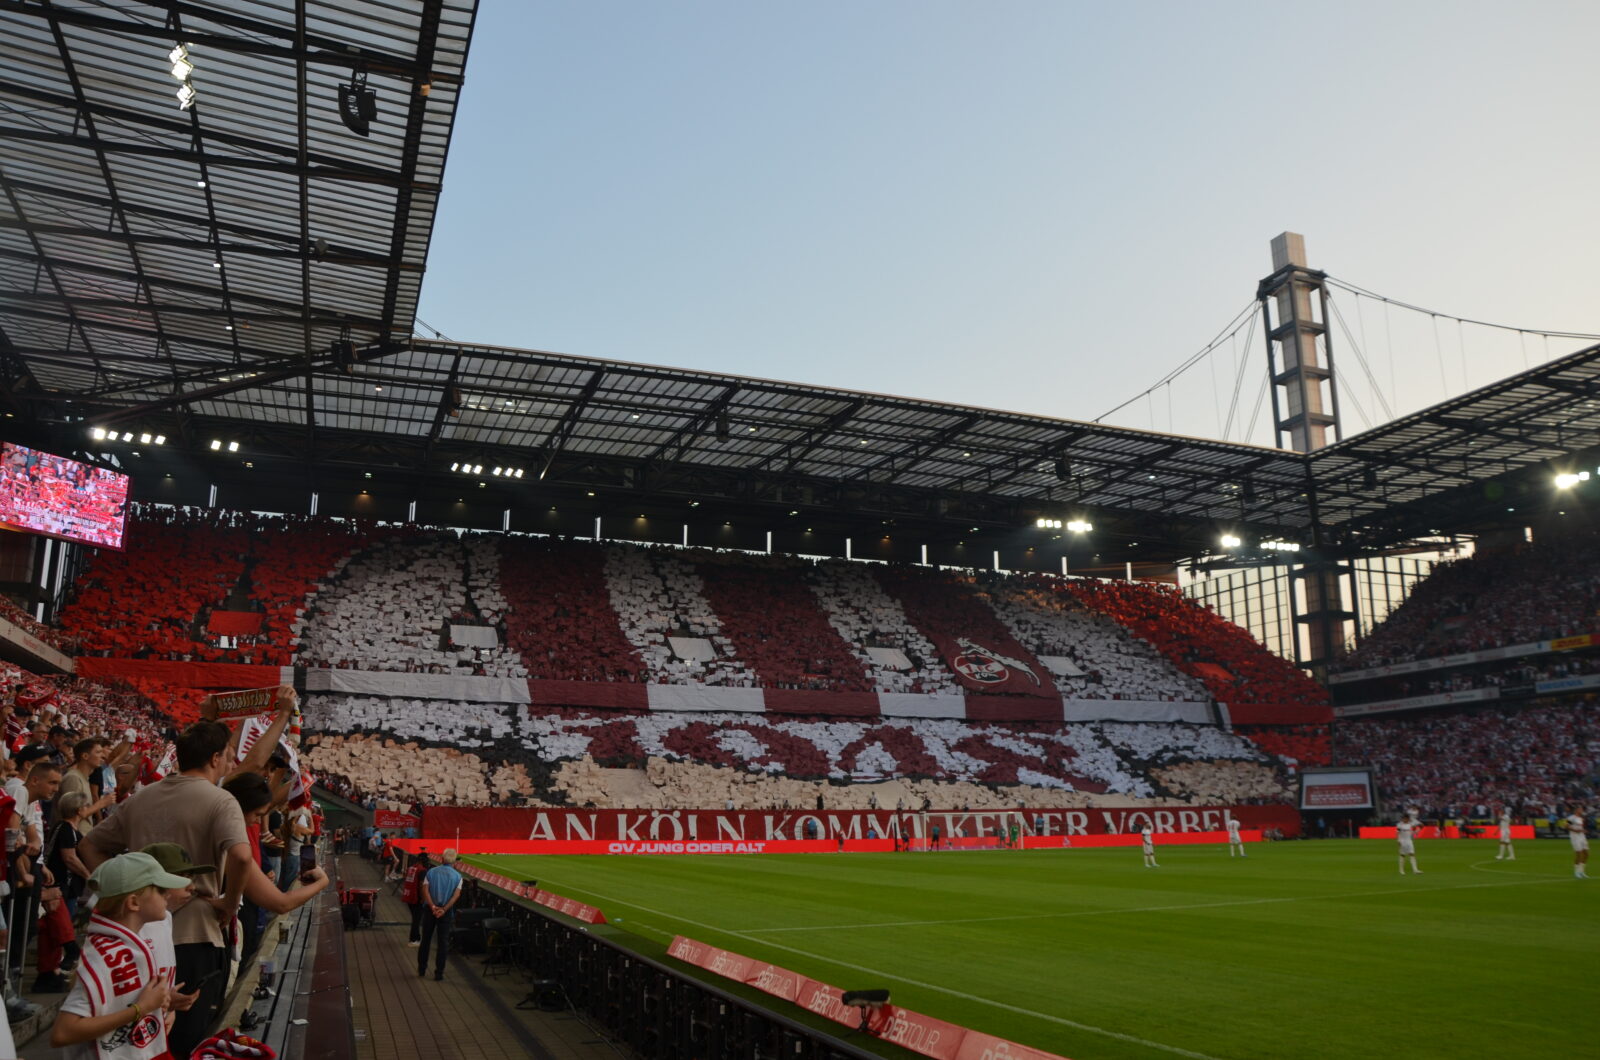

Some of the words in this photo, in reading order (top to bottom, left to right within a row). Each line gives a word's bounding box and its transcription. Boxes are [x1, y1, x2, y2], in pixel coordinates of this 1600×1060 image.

[528, 812, 597, 840] AN
[617, 809, 746, 840] KÖLN
[763, 811, 931, 841] KOMMT
[637, 843, 684, 854] JUNG
[686, 843, 736, 854] ODER
[735, 843, 766, 854] ALT
[881, 1012, 941, 1054] DERTOUR
